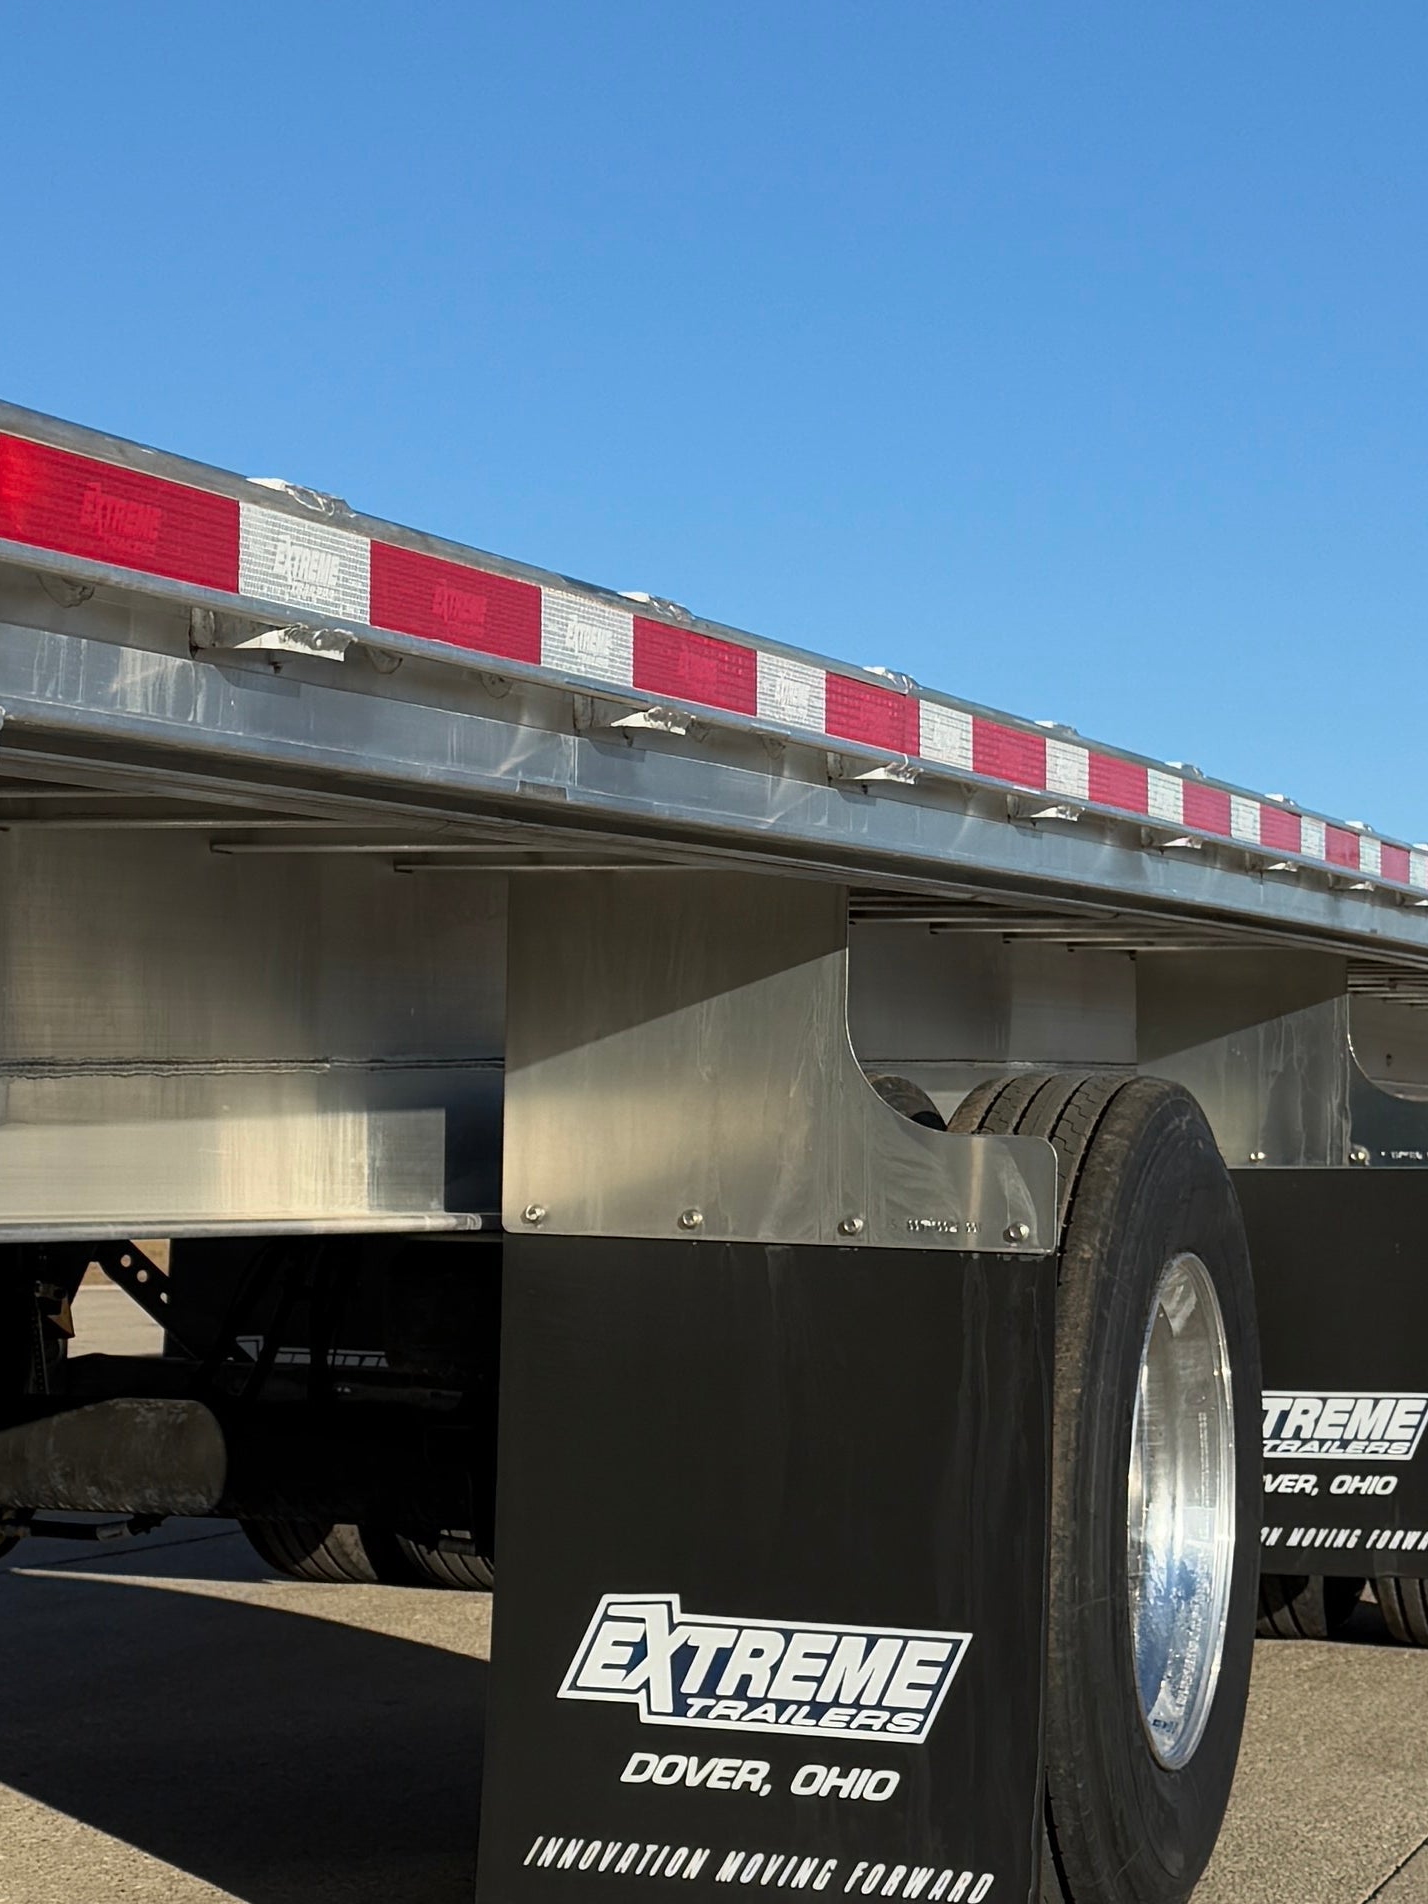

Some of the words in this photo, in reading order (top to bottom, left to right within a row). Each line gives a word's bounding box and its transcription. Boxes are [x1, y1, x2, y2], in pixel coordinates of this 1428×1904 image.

[1261, 1397, 1427, 1440] TREME
[1262, 1439, 1411, 1455] TRAILERS
[1262, 1473, 1319, 1496] VER,
[1329, 1474, 1399, 1496] OHIO
[1285, 1527, 1362, 1549] MOVING
[576, 1603, 953, 1713] EXTREME
[685, 1697, 925, 1733] TRAILERS
[619, 1752, 772, 1796] DOVER,
[790, 1764, 901, 1801] OHIO
[523, 1835, 710, 1880] INNOVATION
[715, 1850, 837, 1891] MOVING
[843, 1861, 994, 1904] FORWARD
